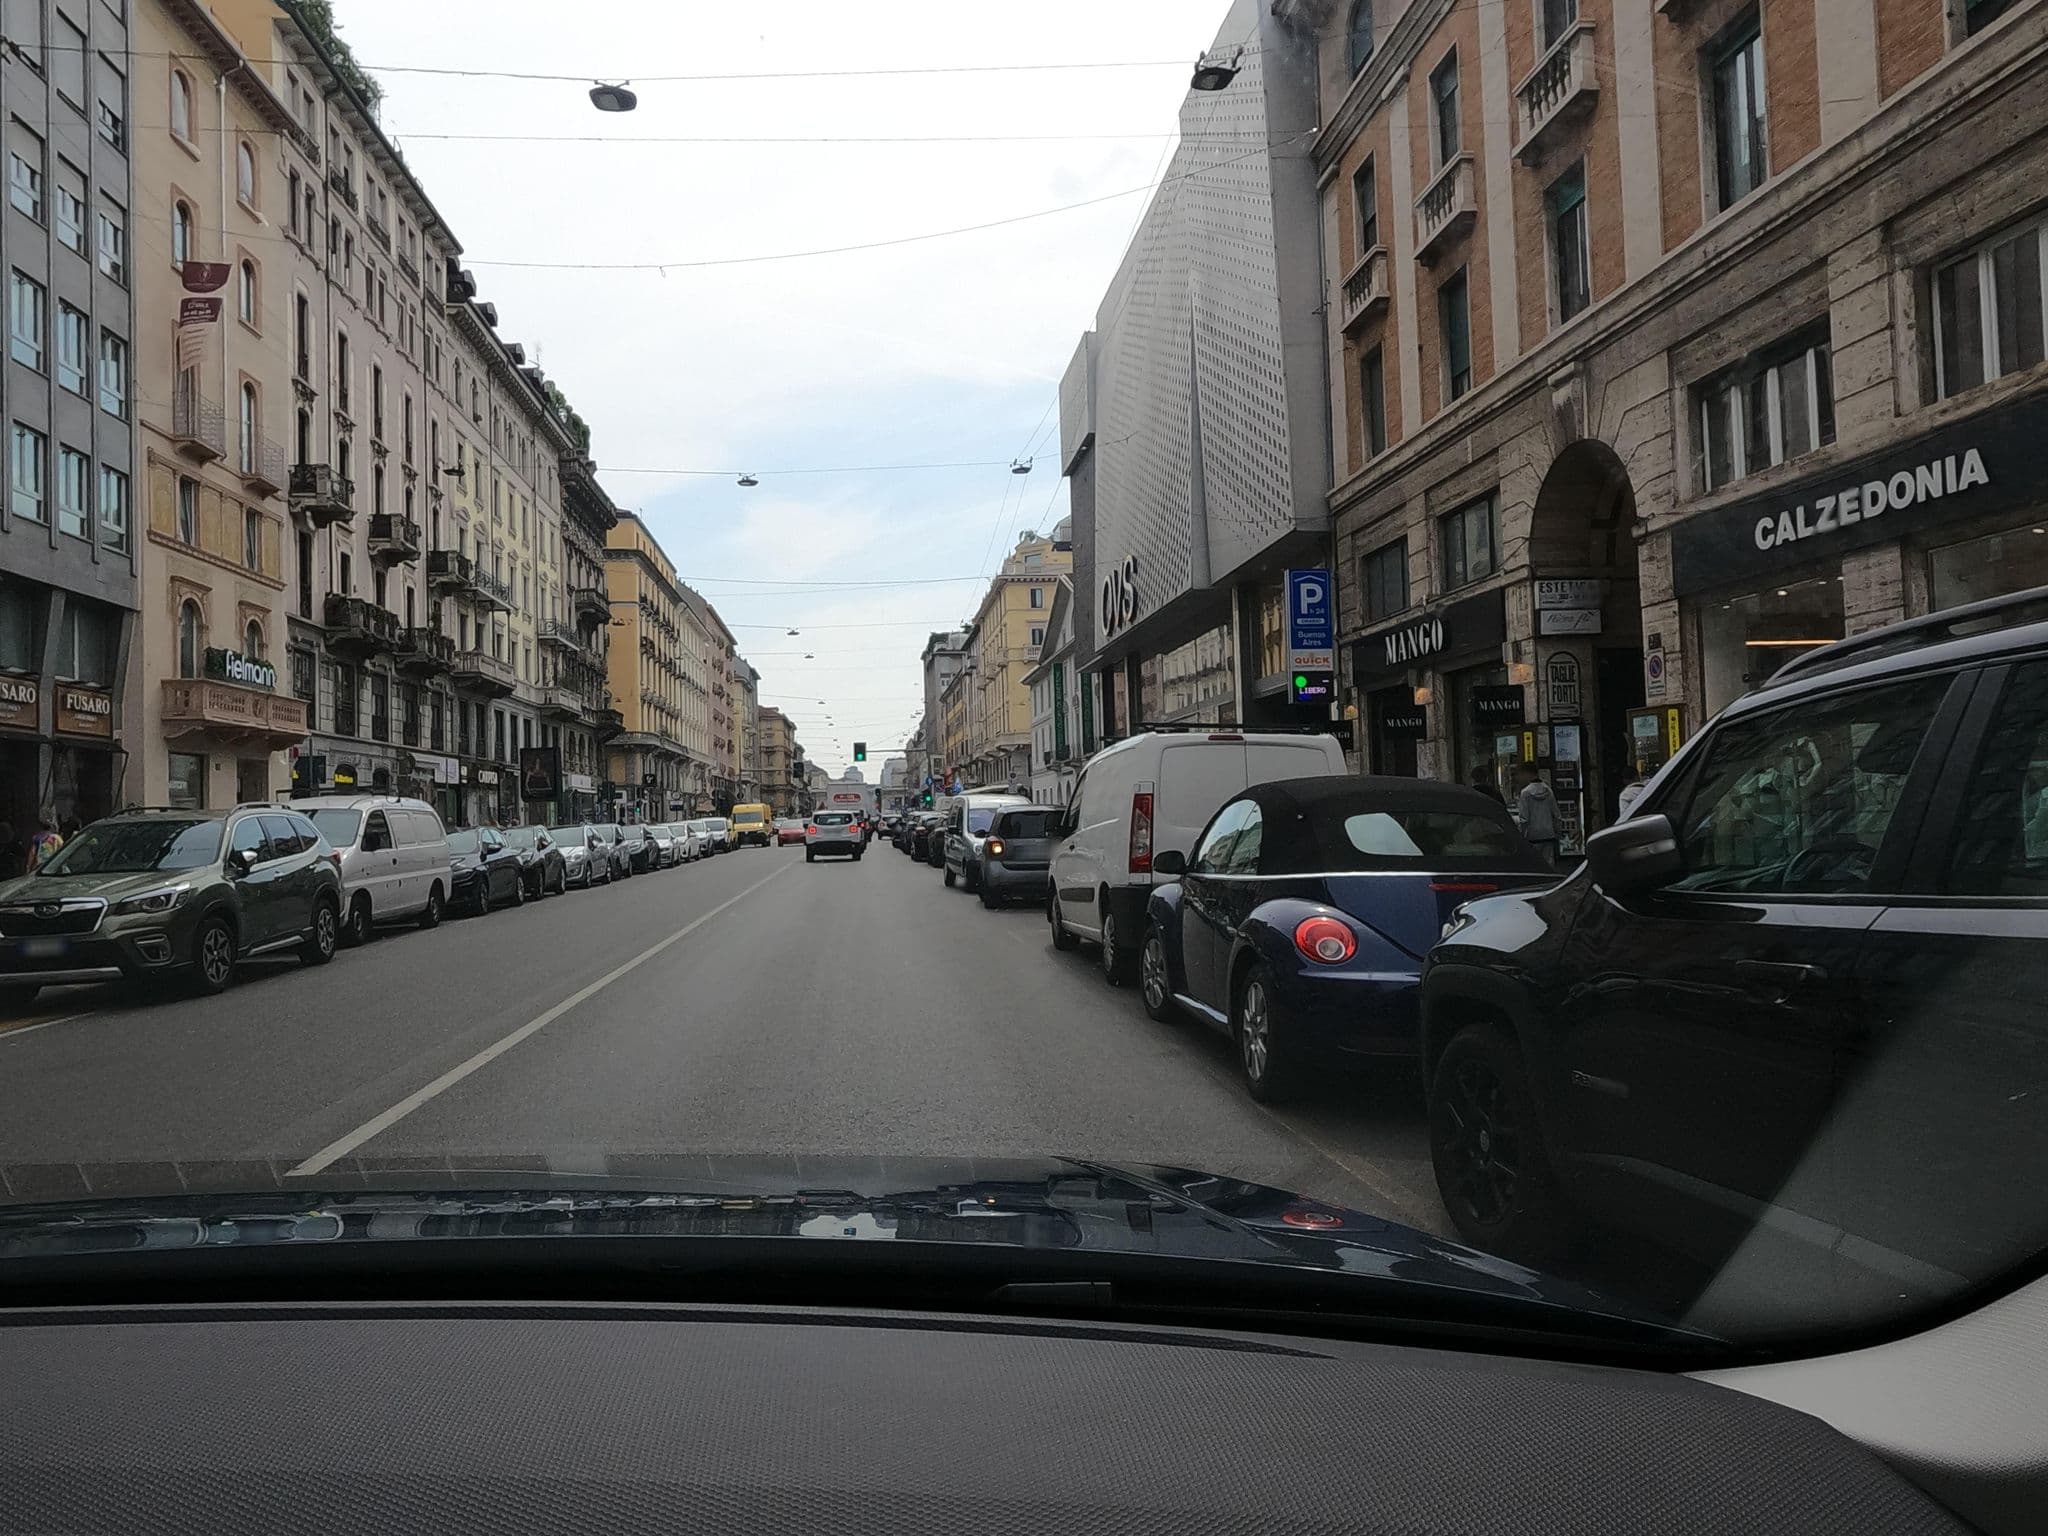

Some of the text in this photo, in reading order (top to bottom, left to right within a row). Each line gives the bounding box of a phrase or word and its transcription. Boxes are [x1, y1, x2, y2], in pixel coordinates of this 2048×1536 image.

[1754, 447, 1990, 551] CALZEDONIA
[1102, 554, 1136, 636] OVS
[1300, 583, 1323, 614] P
[1297, 631, 1326, 639] Buenos
[1302, 639, 1322, 647] Aires
[1384, 619, 1443, 666] MANGO
[1551, 664, 1576, 682] TAGLIE
[0, 682, 37, 704] SARO
[1299, 686, 1327, 695] LIBERO
[66, 693, 111, 715] FUSARO
[1479, 700, 1520, 711] MANGO
[1386, 718, 1422, 728] MANGO
